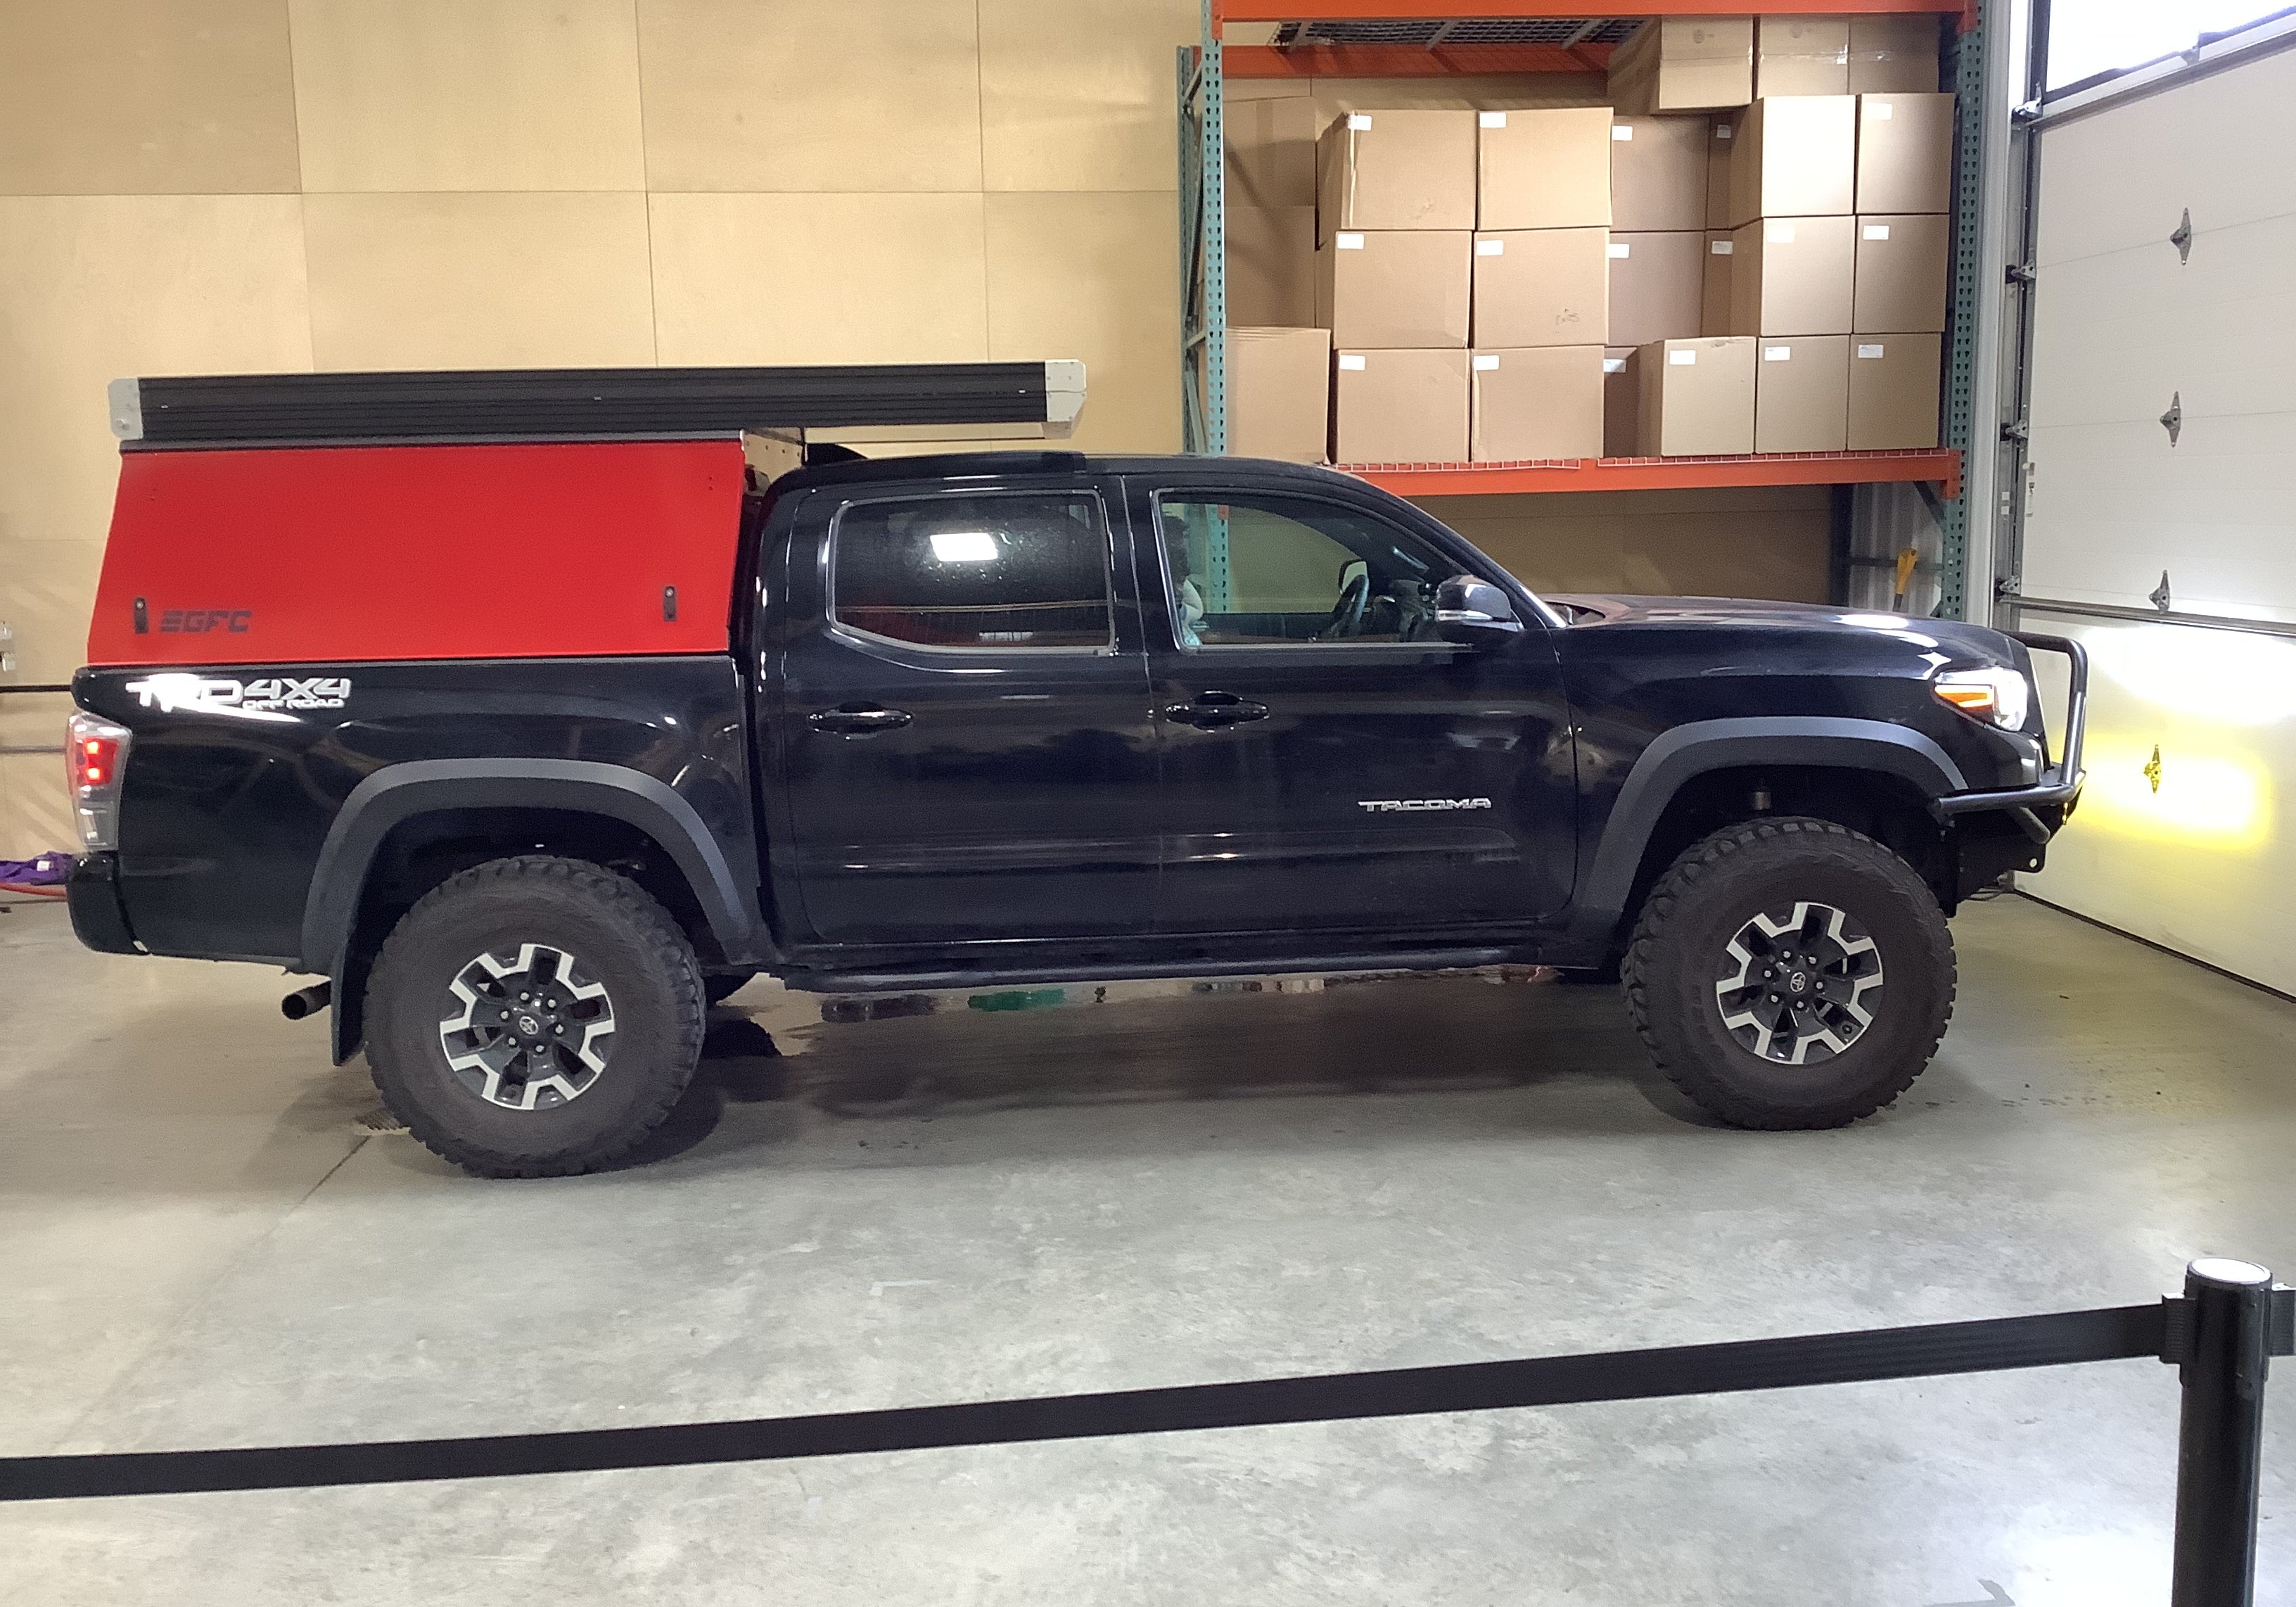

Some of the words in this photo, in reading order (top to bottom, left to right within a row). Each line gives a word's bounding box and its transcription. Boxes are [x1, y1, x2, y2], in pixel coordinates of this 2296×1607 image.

[242, 699, 284, 710] OFF
[286, 699, 345, 709] ROAD
[1358, 798, 1492, 812] TACOMA
